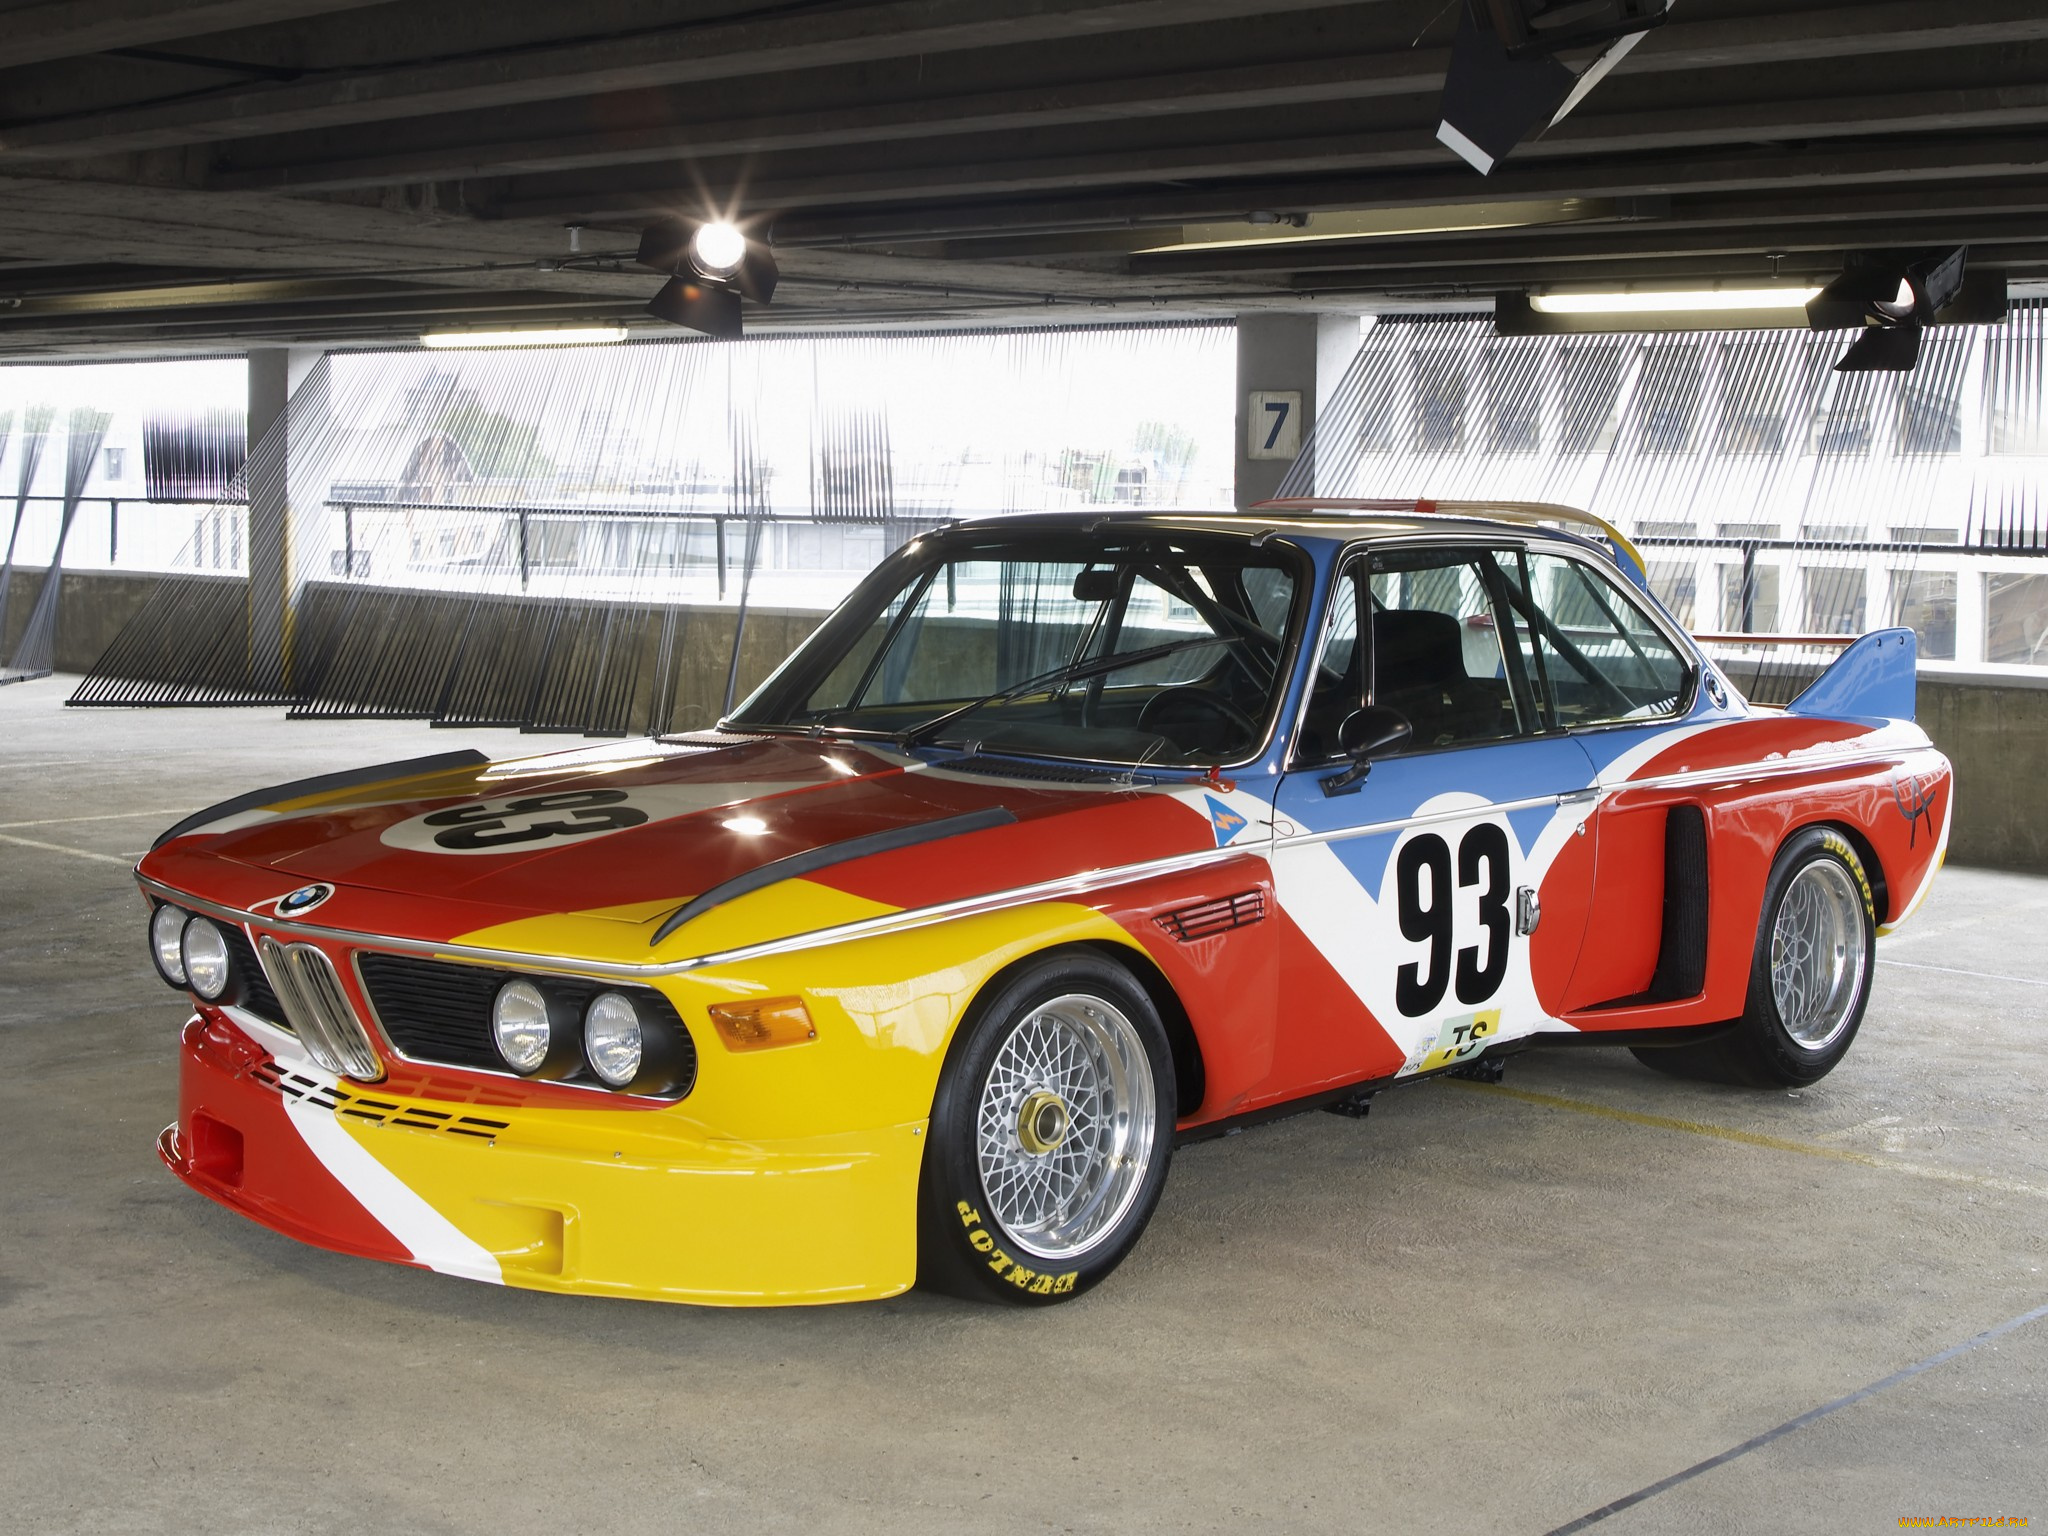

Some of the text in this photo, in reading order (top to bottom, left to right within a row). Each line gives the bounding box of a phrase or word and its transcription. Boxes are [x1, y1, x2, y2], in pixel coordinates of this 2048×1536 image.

[1263, 402, 1290, 449] 7
[423, 789, 650, 850] 93
[1823, 834, 1876, 921] DUNLOP
[1396, 822, 1511, 1018] 93
[1442, 1021, 1488, 1061] TS
[956, 1200, 1079, 1295] DUNLOP
